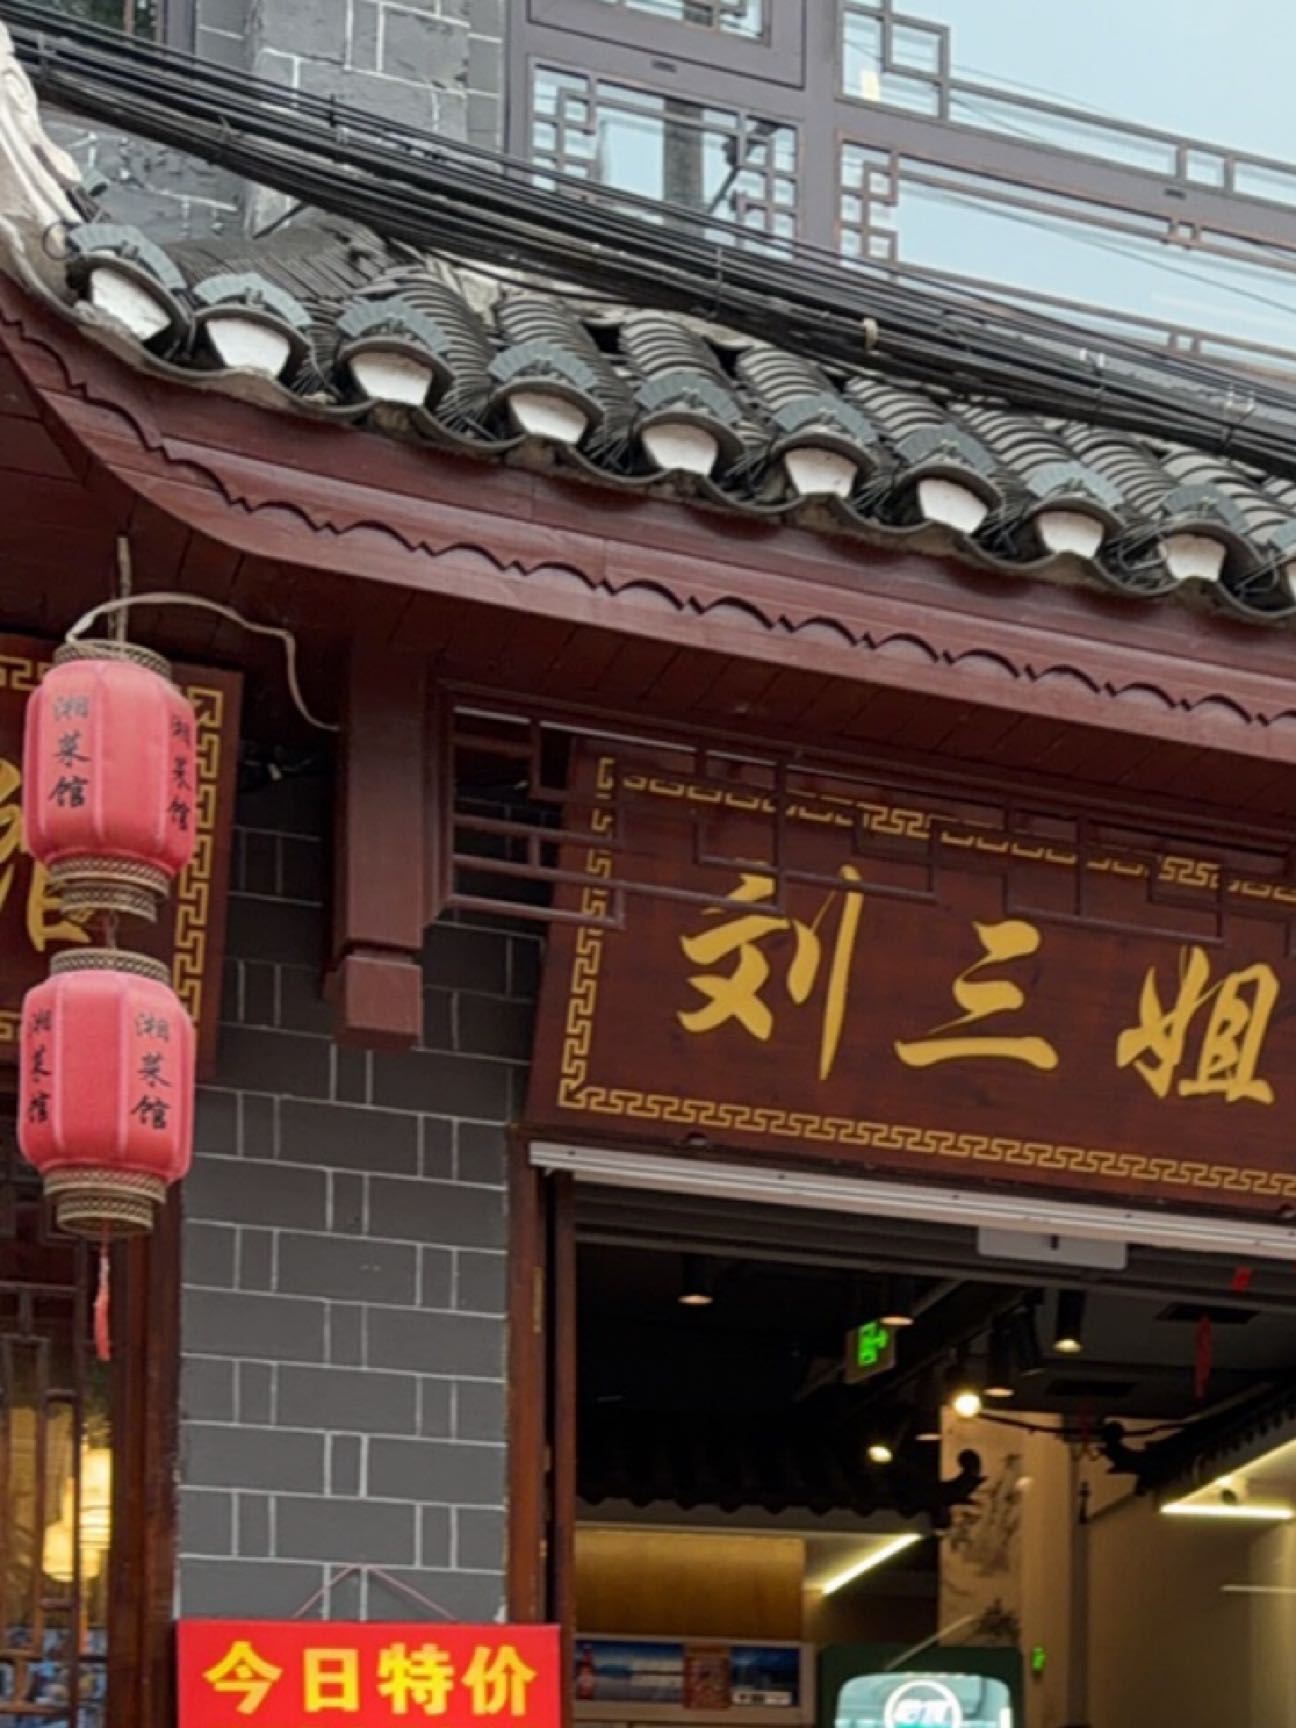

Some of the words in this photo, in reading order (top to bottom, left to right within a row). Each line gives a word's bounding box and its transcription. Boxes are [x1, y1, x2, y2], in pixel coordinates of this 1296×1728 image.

[48, 695, 92, 808] 湘菜馆
[131, 1012, 172, 1130] 湘菜馆
[204, 1640, 537, 1716] 今日特价
